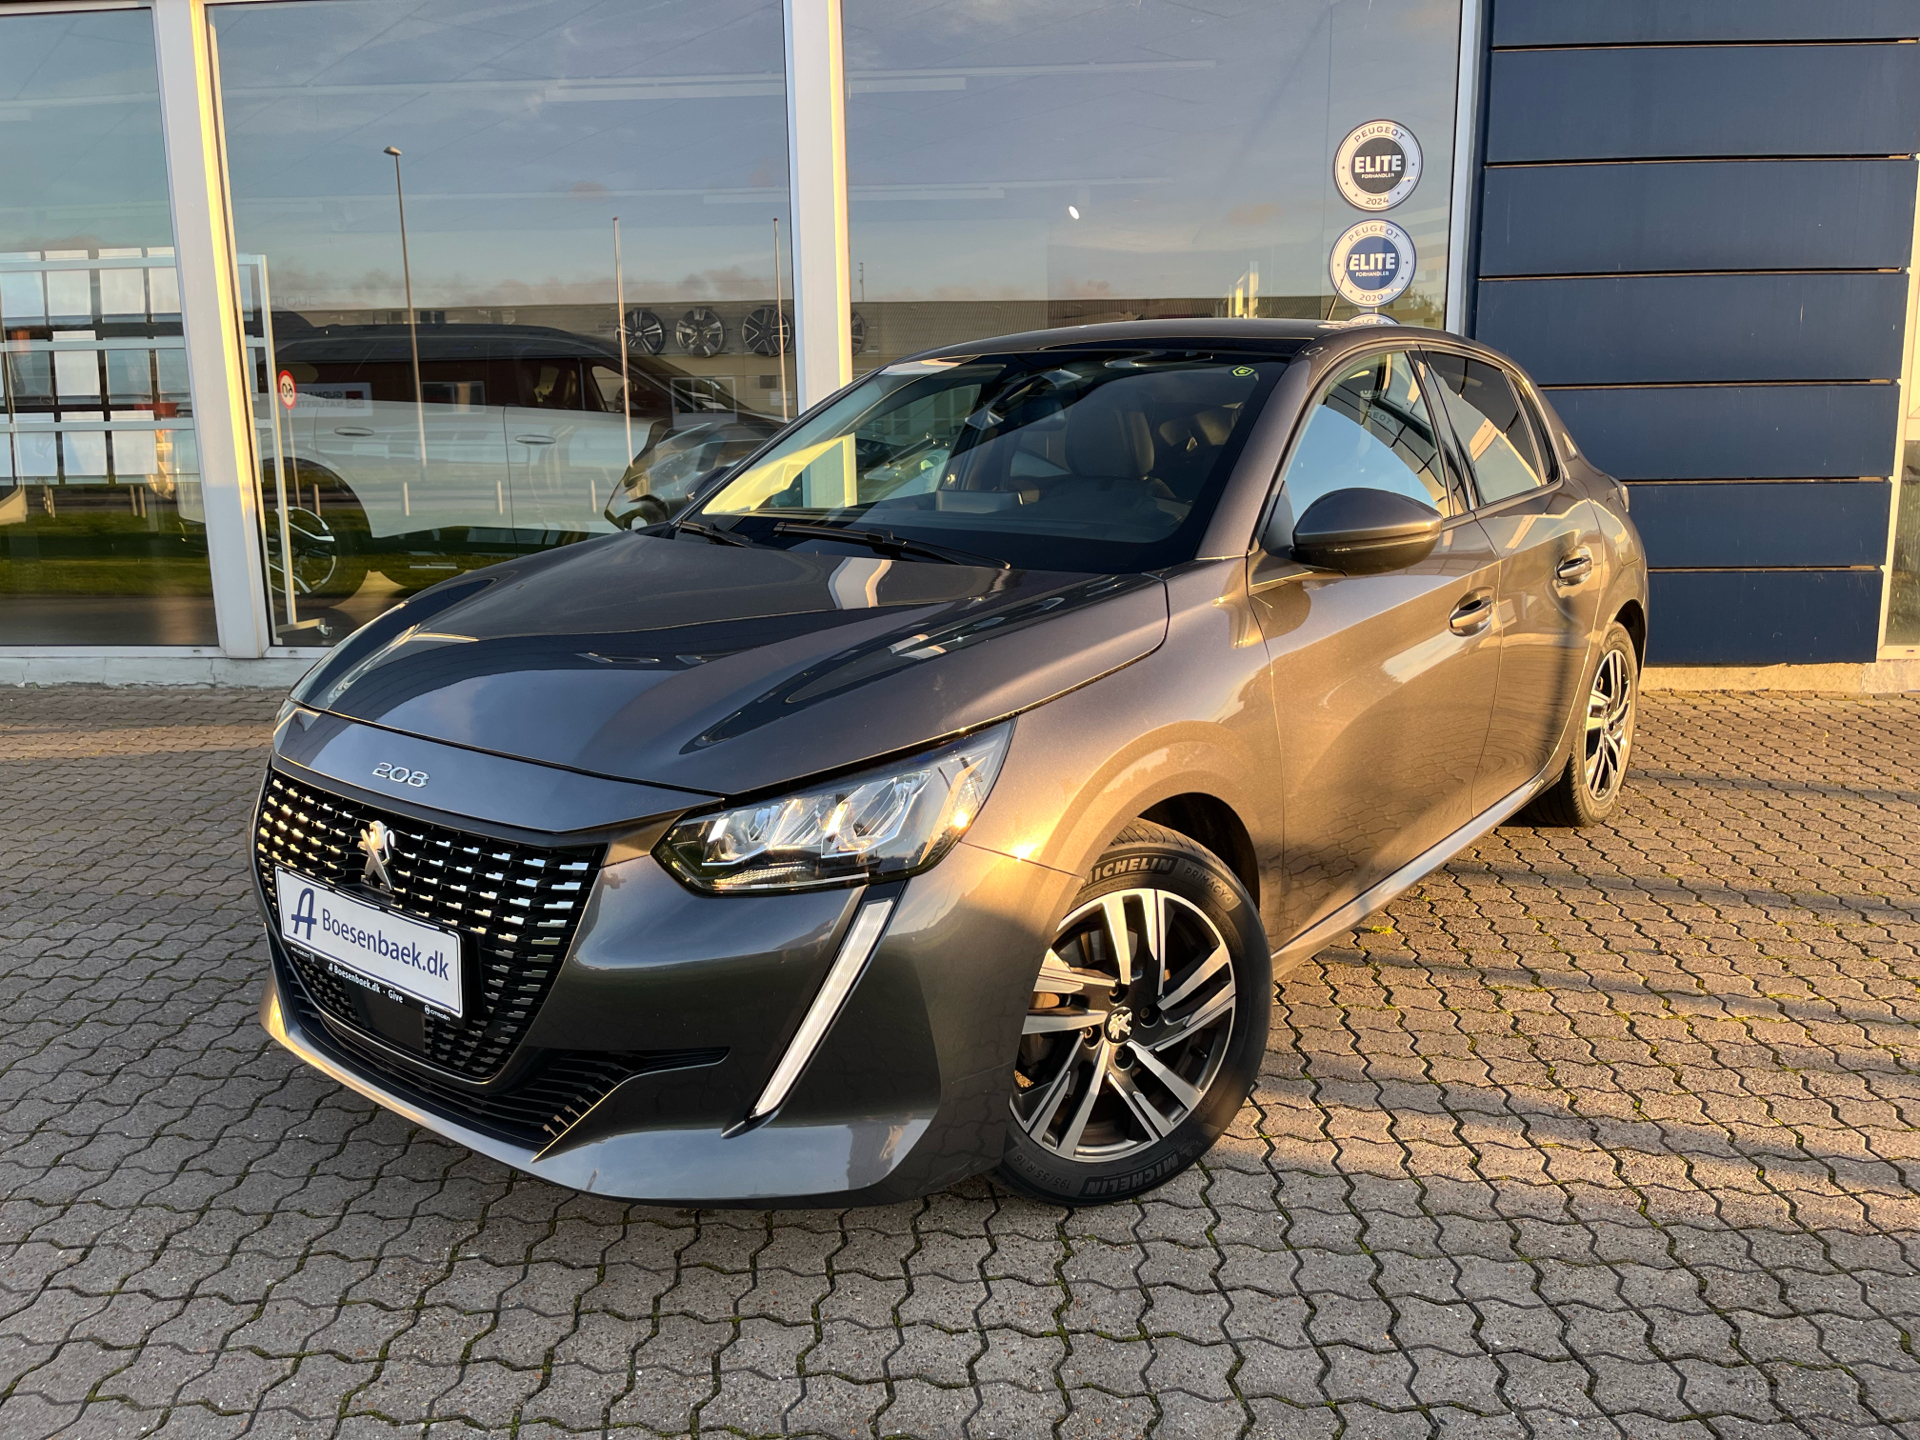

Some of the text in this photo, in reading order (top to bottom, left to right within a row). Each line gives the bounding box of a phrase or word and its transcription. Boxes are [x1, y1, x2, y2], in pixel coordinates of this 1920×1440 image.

[1354, 126, 1405, 143] PEUGEOT
[1354, 154, 1402, 174] ELITE
[1365, 196, 1389, 206] 2024
[1348, 224, 1400, 242] PEUGEOT
[1349, 252, 1396, 271] ELITE
[1359, 293, 1384, 302] 2020
[372, 762, 430, 788] 208
[1183, 867, 1228, 898] PRIMACY
[322, 908, 449, 981] Boesenbaek.dk
[334, 964, 381, 994] Boesenbaek.dk
[388, 989, 404, 1004] Give
[1014, 1154, 1027, 1166] 16
[1026, 1163, 1036, 1173] R
[1035, 1169, 1071, 1189] 195/55
[1084, 1153, 1179, 1194] MICHELIN
